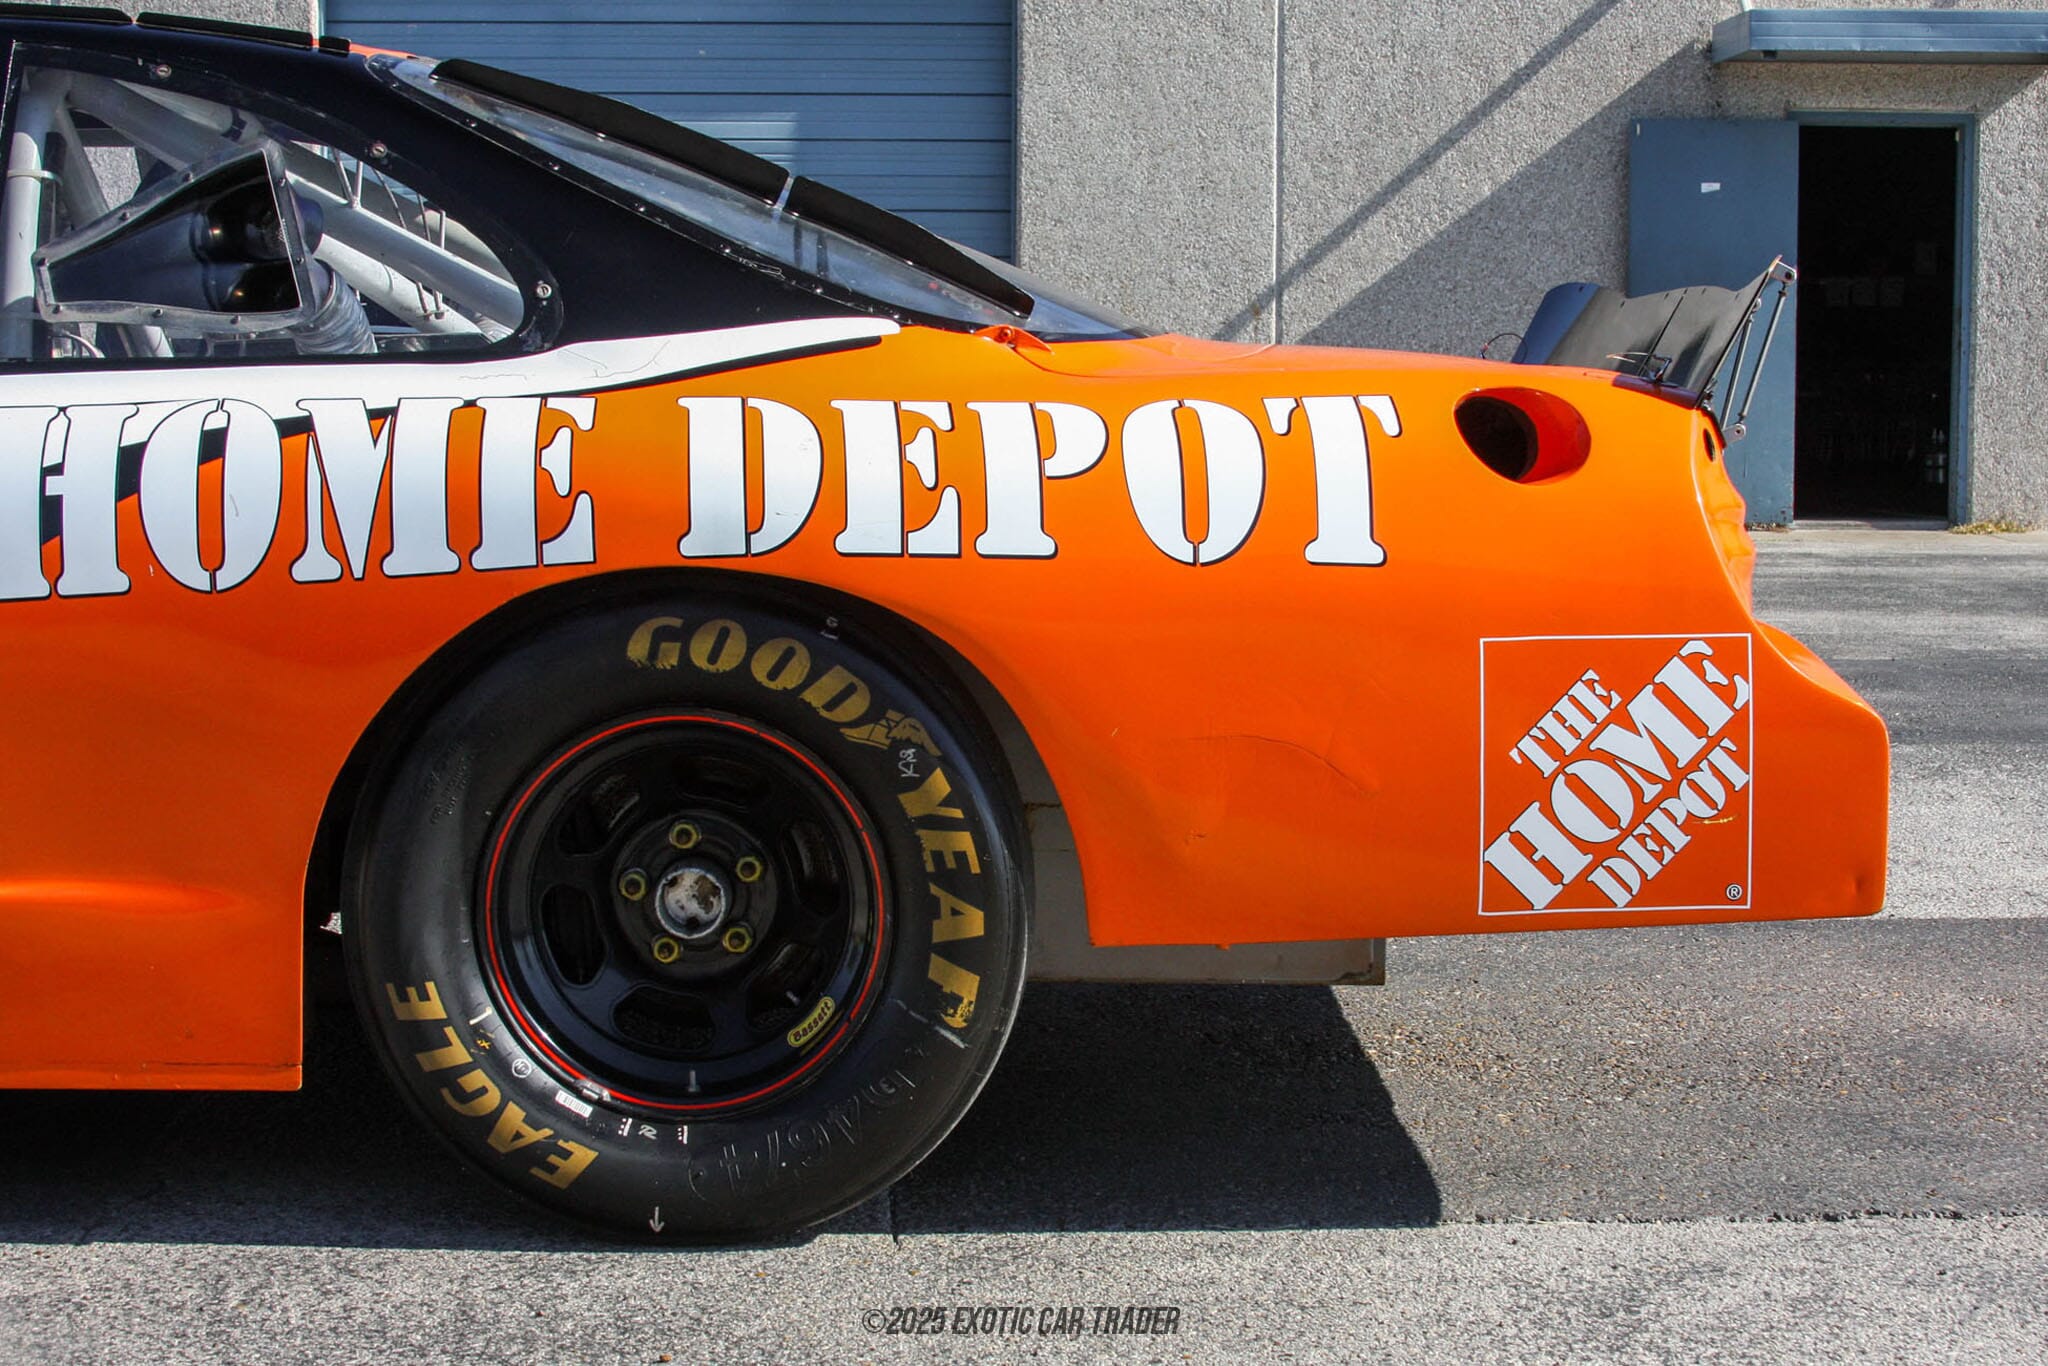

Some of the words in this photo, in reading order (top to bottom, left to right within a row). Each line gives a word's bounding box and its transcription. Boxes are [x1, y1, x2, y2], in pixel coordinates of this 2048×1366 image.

[0, 397, 597, 602] HOME
[677, 395, 1402, 568] DEPOT
[1483, 639, 1750, 910] HOME
[1508, 668, 1623, 778] THE
[1586, 737, 1750, 909] DEPOT
[385, 981, 599, 1190] EAGLE
